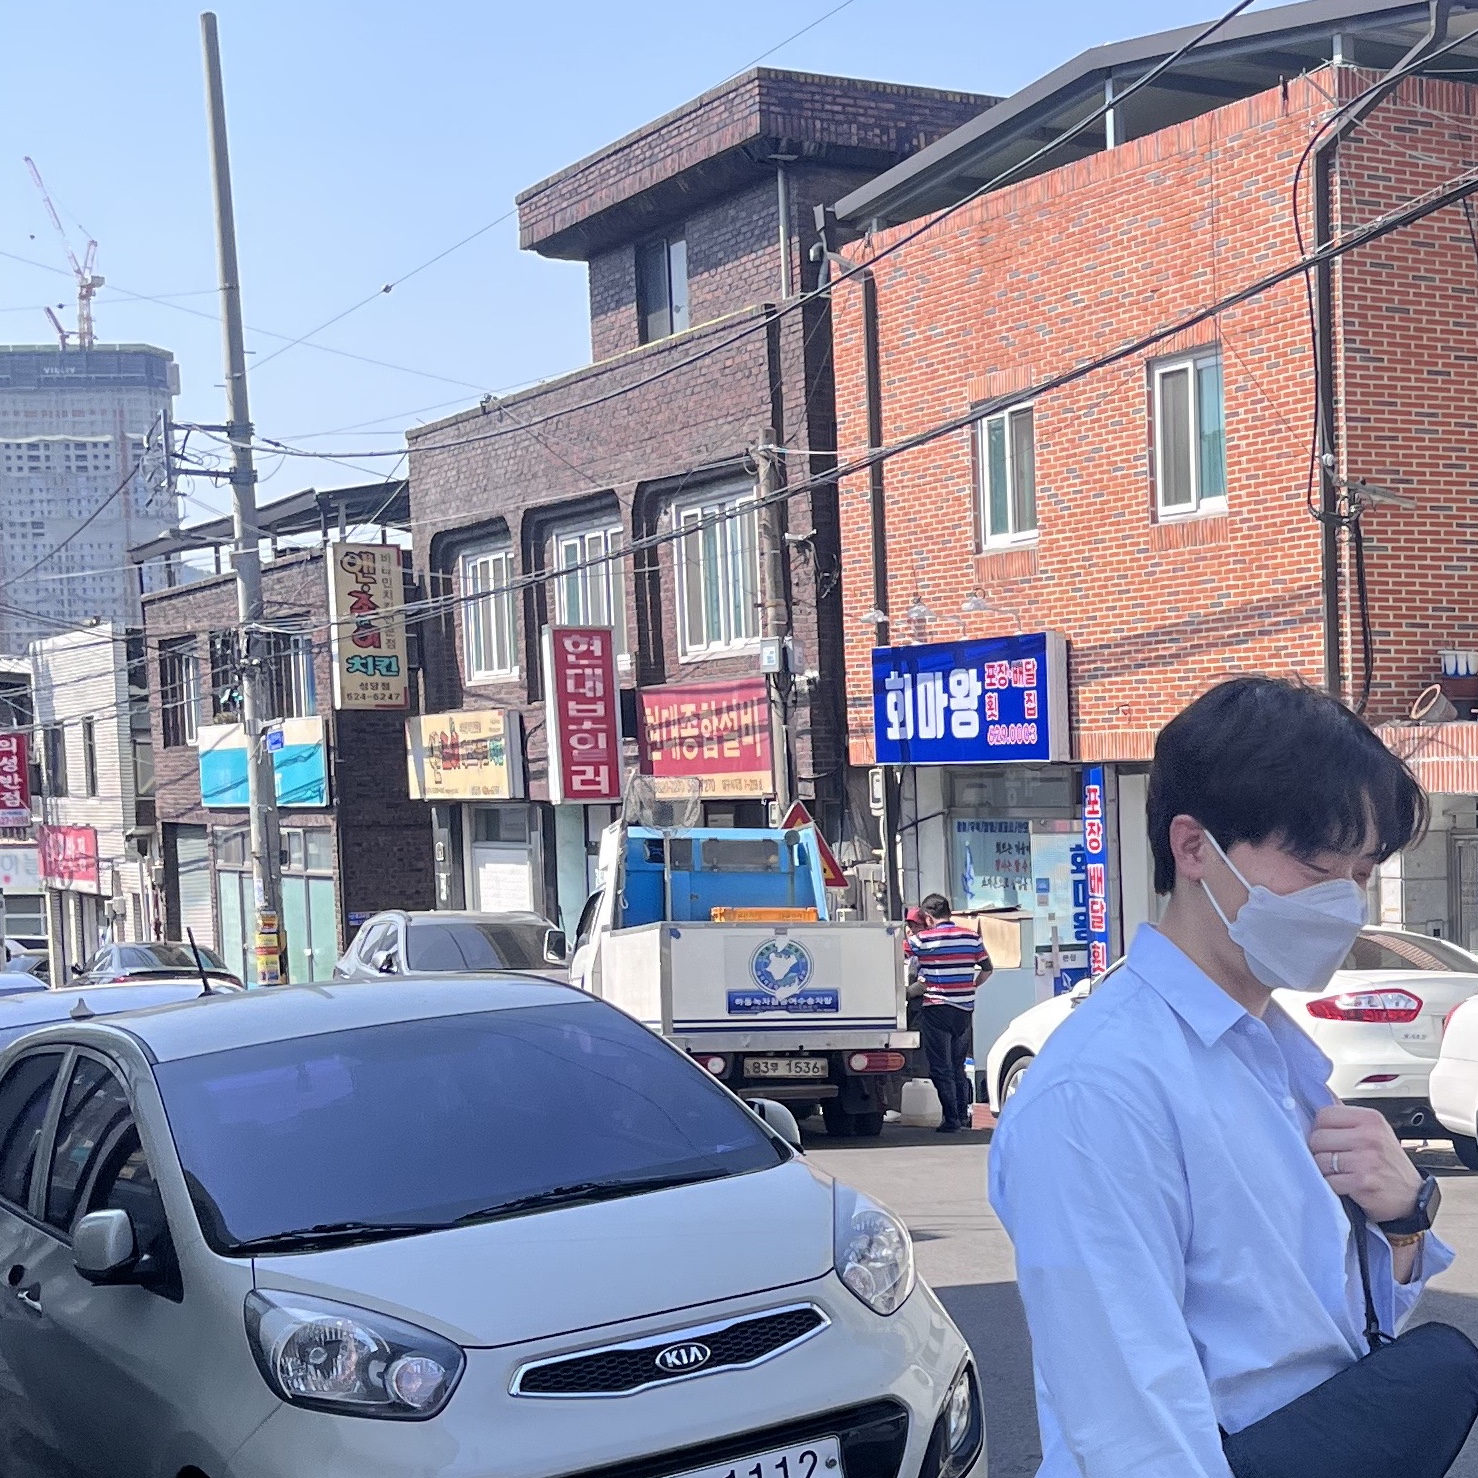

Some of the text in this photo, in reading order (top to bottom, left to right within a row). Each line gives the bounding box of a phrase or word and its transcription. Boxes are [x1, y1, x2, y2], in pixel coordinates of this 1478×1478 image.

[346, 655, 400, 678] 치킨
[562, 633, 610, 795] 현대보일러
[643, 696, 762, 761] 현대종합설비
[885, 668, 982, 741] 회마왕
[1085, 785, 1102, 853] 포장
[1088, 864, 1106, 932] 배달
[785, 1060, 820, 1074] 1536
[664, 1346, 704, 1368] KIA
